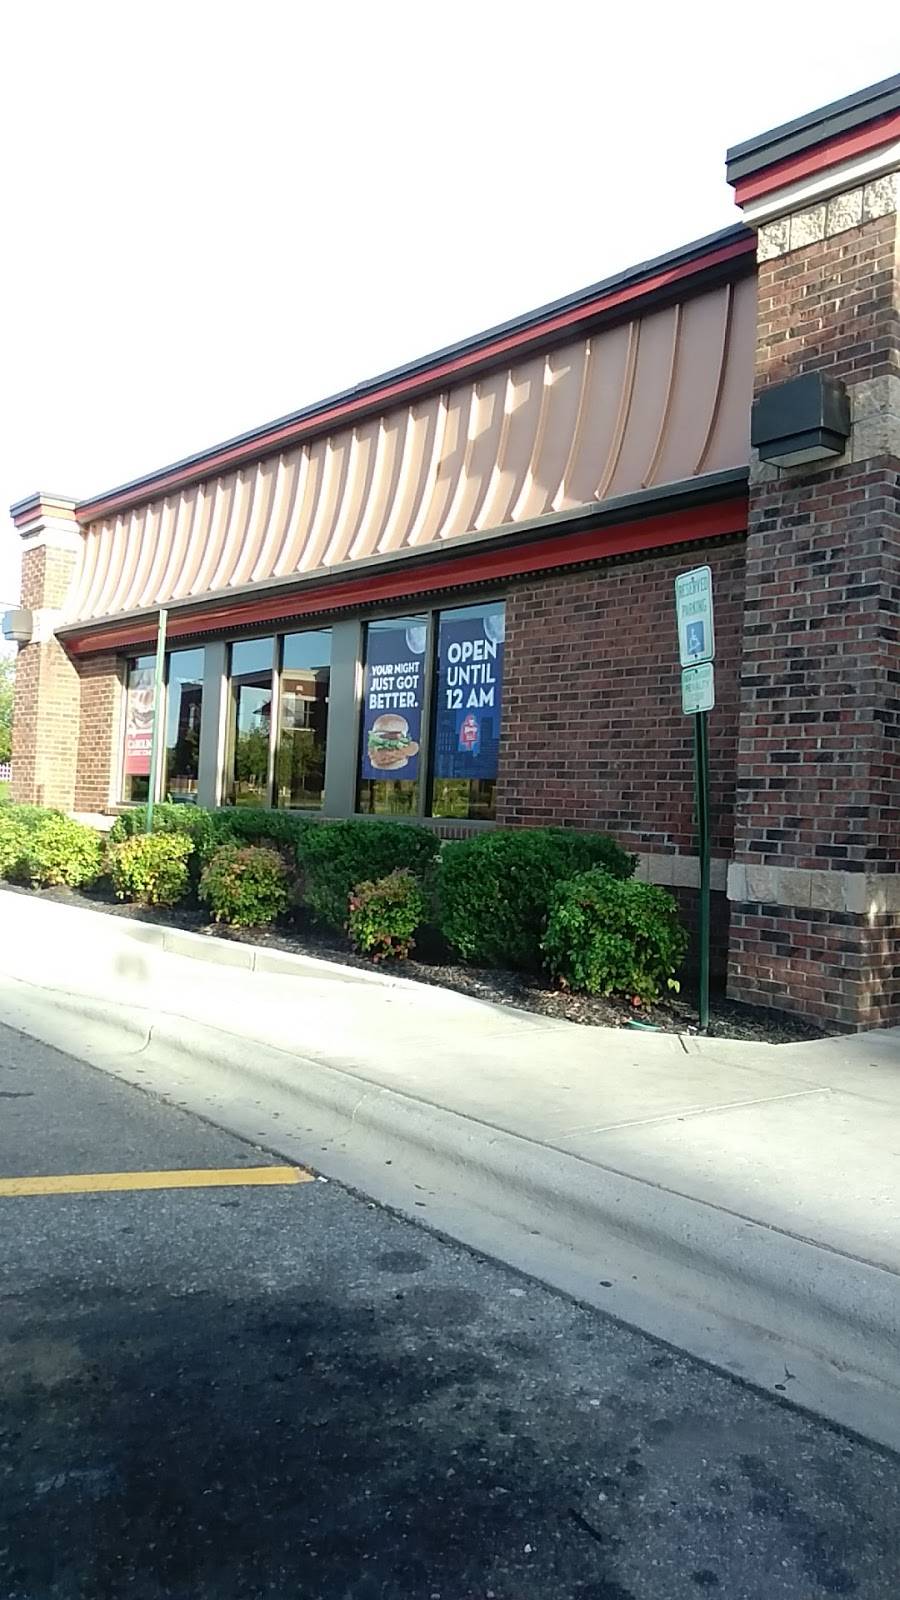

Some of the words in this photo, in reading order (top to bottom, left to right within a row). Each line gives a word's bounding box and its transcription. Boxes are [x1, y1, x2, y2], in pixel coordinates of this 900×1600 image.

[447, 640, 497, 663] OPEN
[371, 665, 393, 676] YOUR
[394, 662, 420, 674] NIGHT
[447, 664, 496, 687] UNTIL
[370, 677, 394, 691] JUST
[396, 675, 419, 689] GOT
[369, 692, 418, 710] BETTER.
[446, 688, 463, 709] 12
[466, 686, 495, 708] AM
